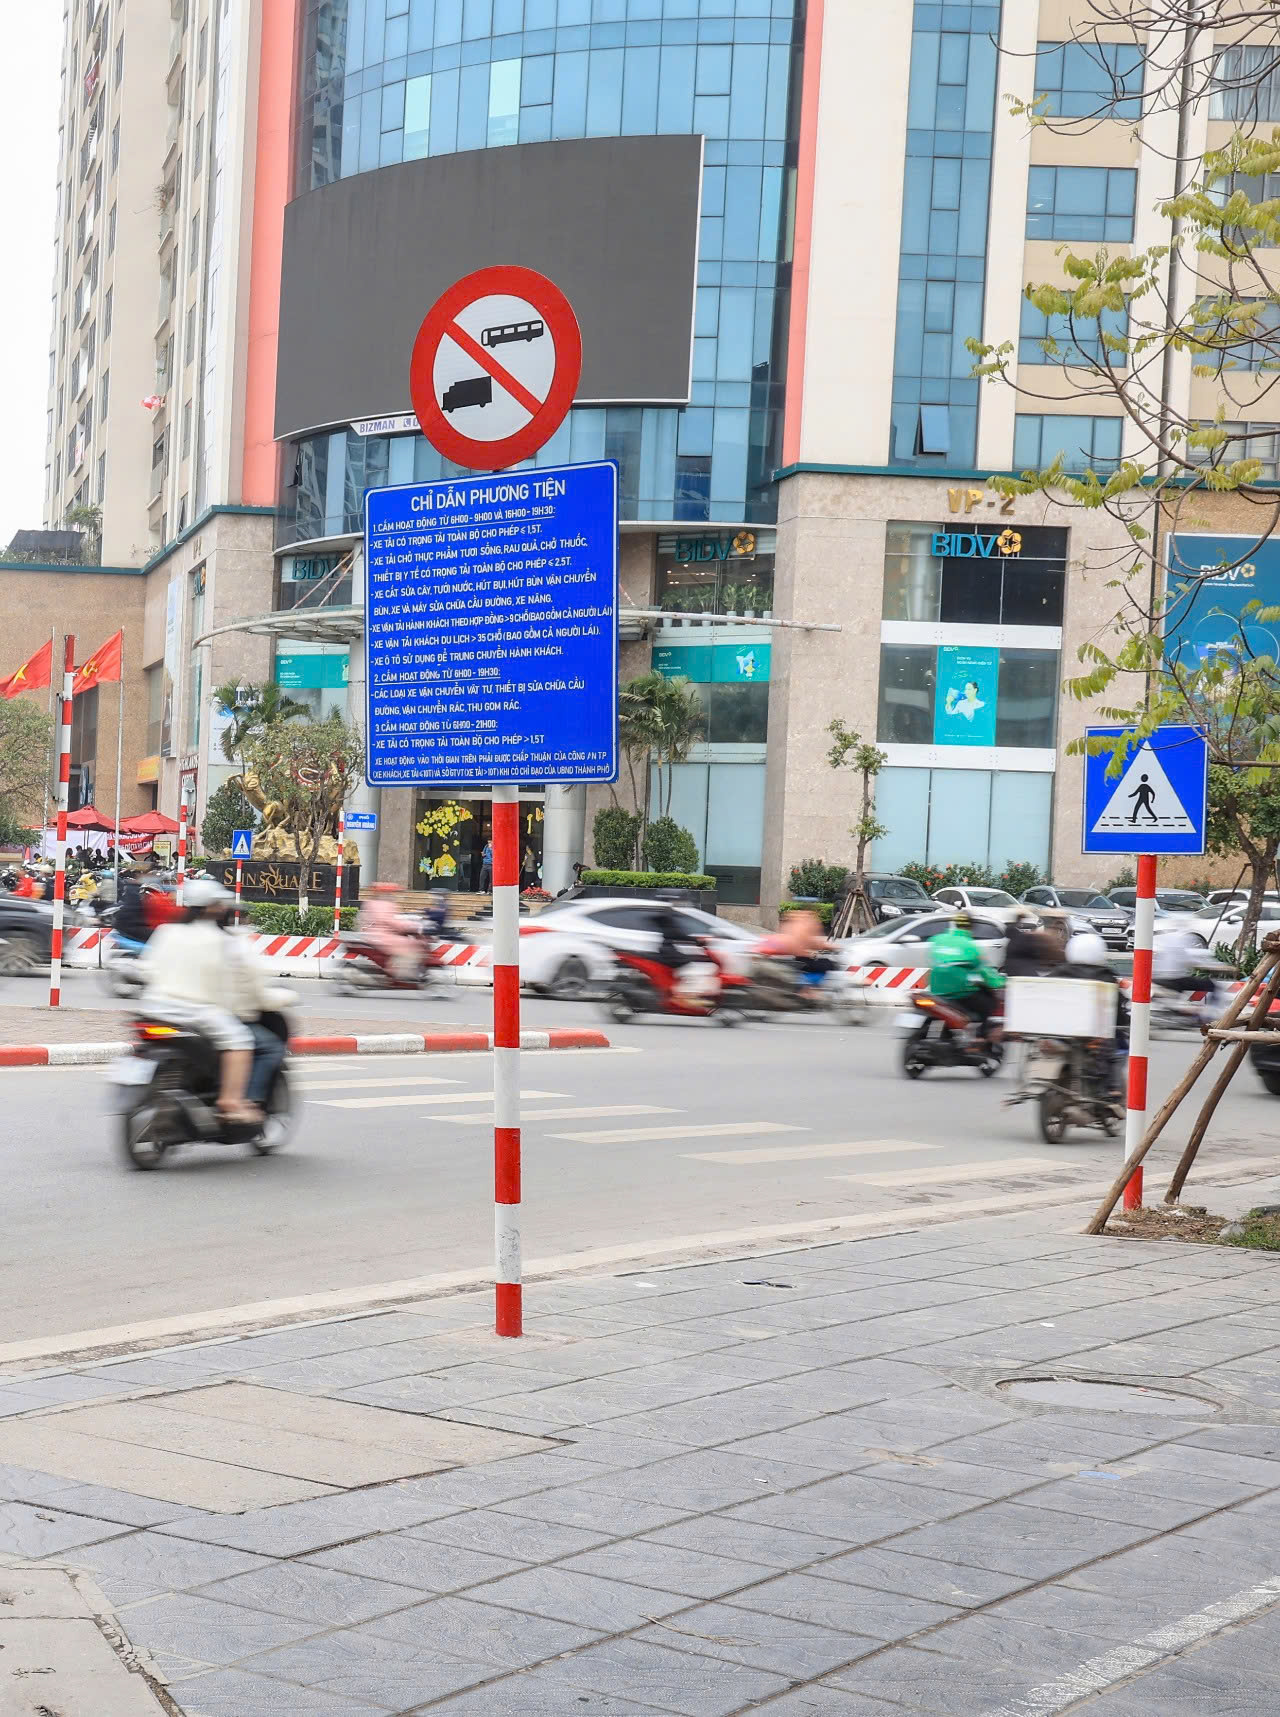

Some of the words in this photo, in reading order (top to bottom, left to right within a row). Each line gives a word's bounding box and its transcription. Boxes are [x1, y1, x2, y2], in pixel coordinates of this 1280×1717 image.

[360, 419, 395, 433] BIZMAN
[411, 489, 433, 511] CHỈ
[436, 486, 465, 509] DẪN
[470, 483, 529, 505] PHƯƠNG
[532, 477, 565, 500] TIỆN
[674, 535, 734, 563] BIDV
[931, 532, 1000, 558] BIDV
